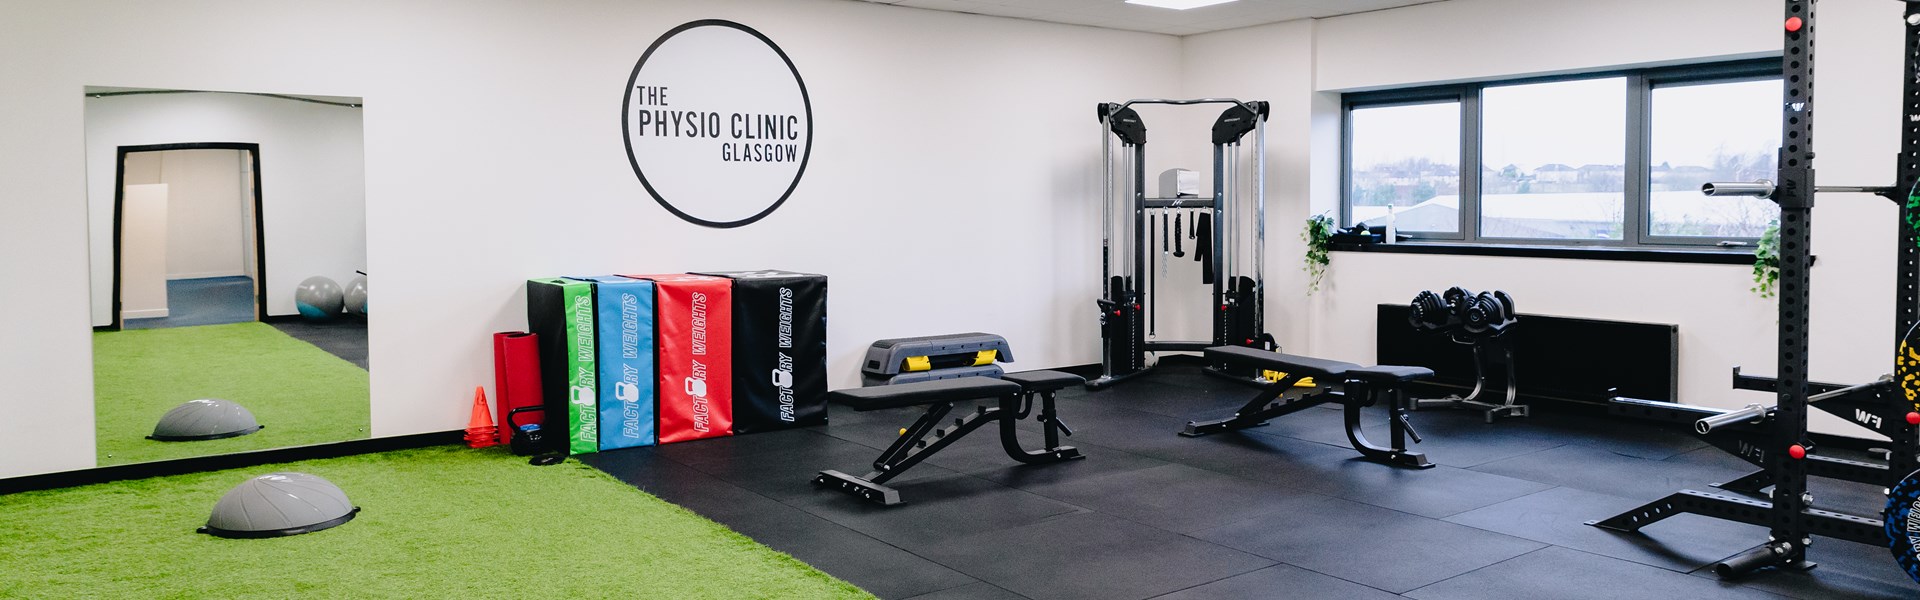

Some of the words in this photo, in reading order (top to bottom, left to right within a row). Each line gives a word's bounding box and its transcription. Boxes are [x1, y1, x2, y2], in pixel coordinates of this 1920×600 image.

[636, 85, 669, 106] THE
[638, 109, 721, 138] PHYSIO
[730, 113, 799, 141] CLINIC
[721, 142, 798, 163] GLASGOW
[574, 295, 593, 362] WEIGHTS
[621, 292, 638, 359] WEIGHTS
[692, 292, 707, 356] WEIGHTS
[779, 287, 793, 349] WEIGHTS
